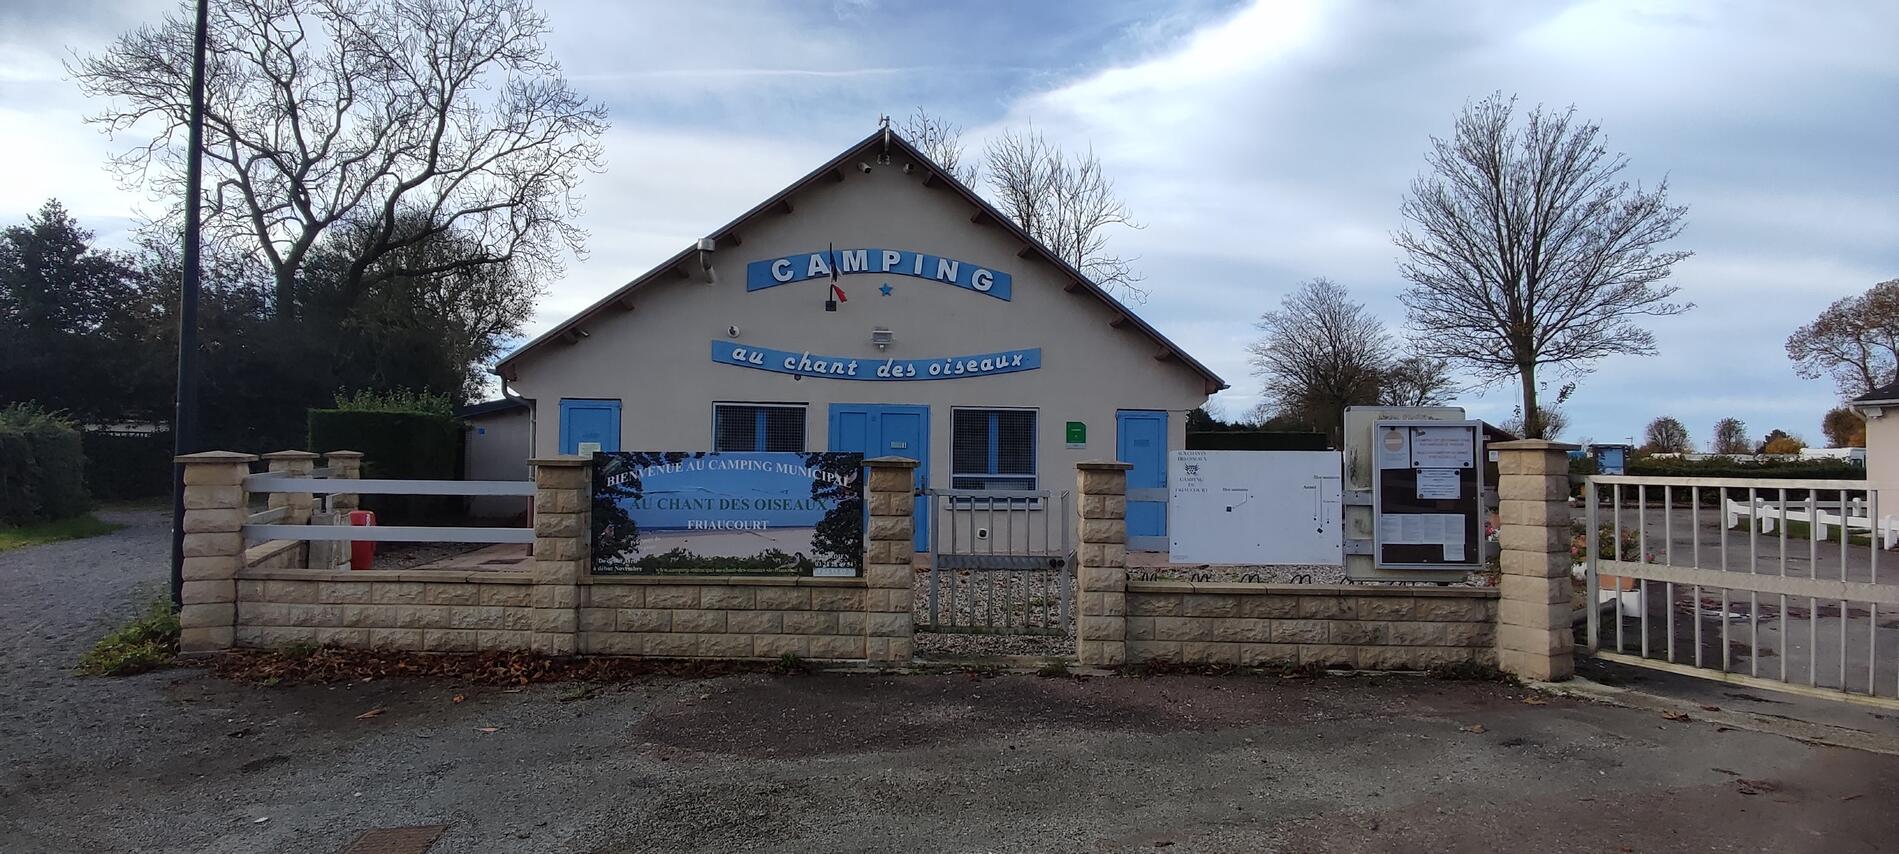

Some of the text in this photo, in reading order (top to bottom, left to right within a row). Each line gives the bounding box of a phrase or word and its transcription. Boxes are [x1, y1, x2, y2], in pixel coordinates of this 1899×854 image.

[771, 249, 994, 292] CAMPING
[732, 347, 1023, 378] au chant des oiseaux
[606, 459, 852, 489] BIENVENUE AU CAMPING MUNICIPAL
[630, 498, 828, 512] AU CHANT DES OISEAUX
[687, 519, 769, 531] FRIAUCOURT
